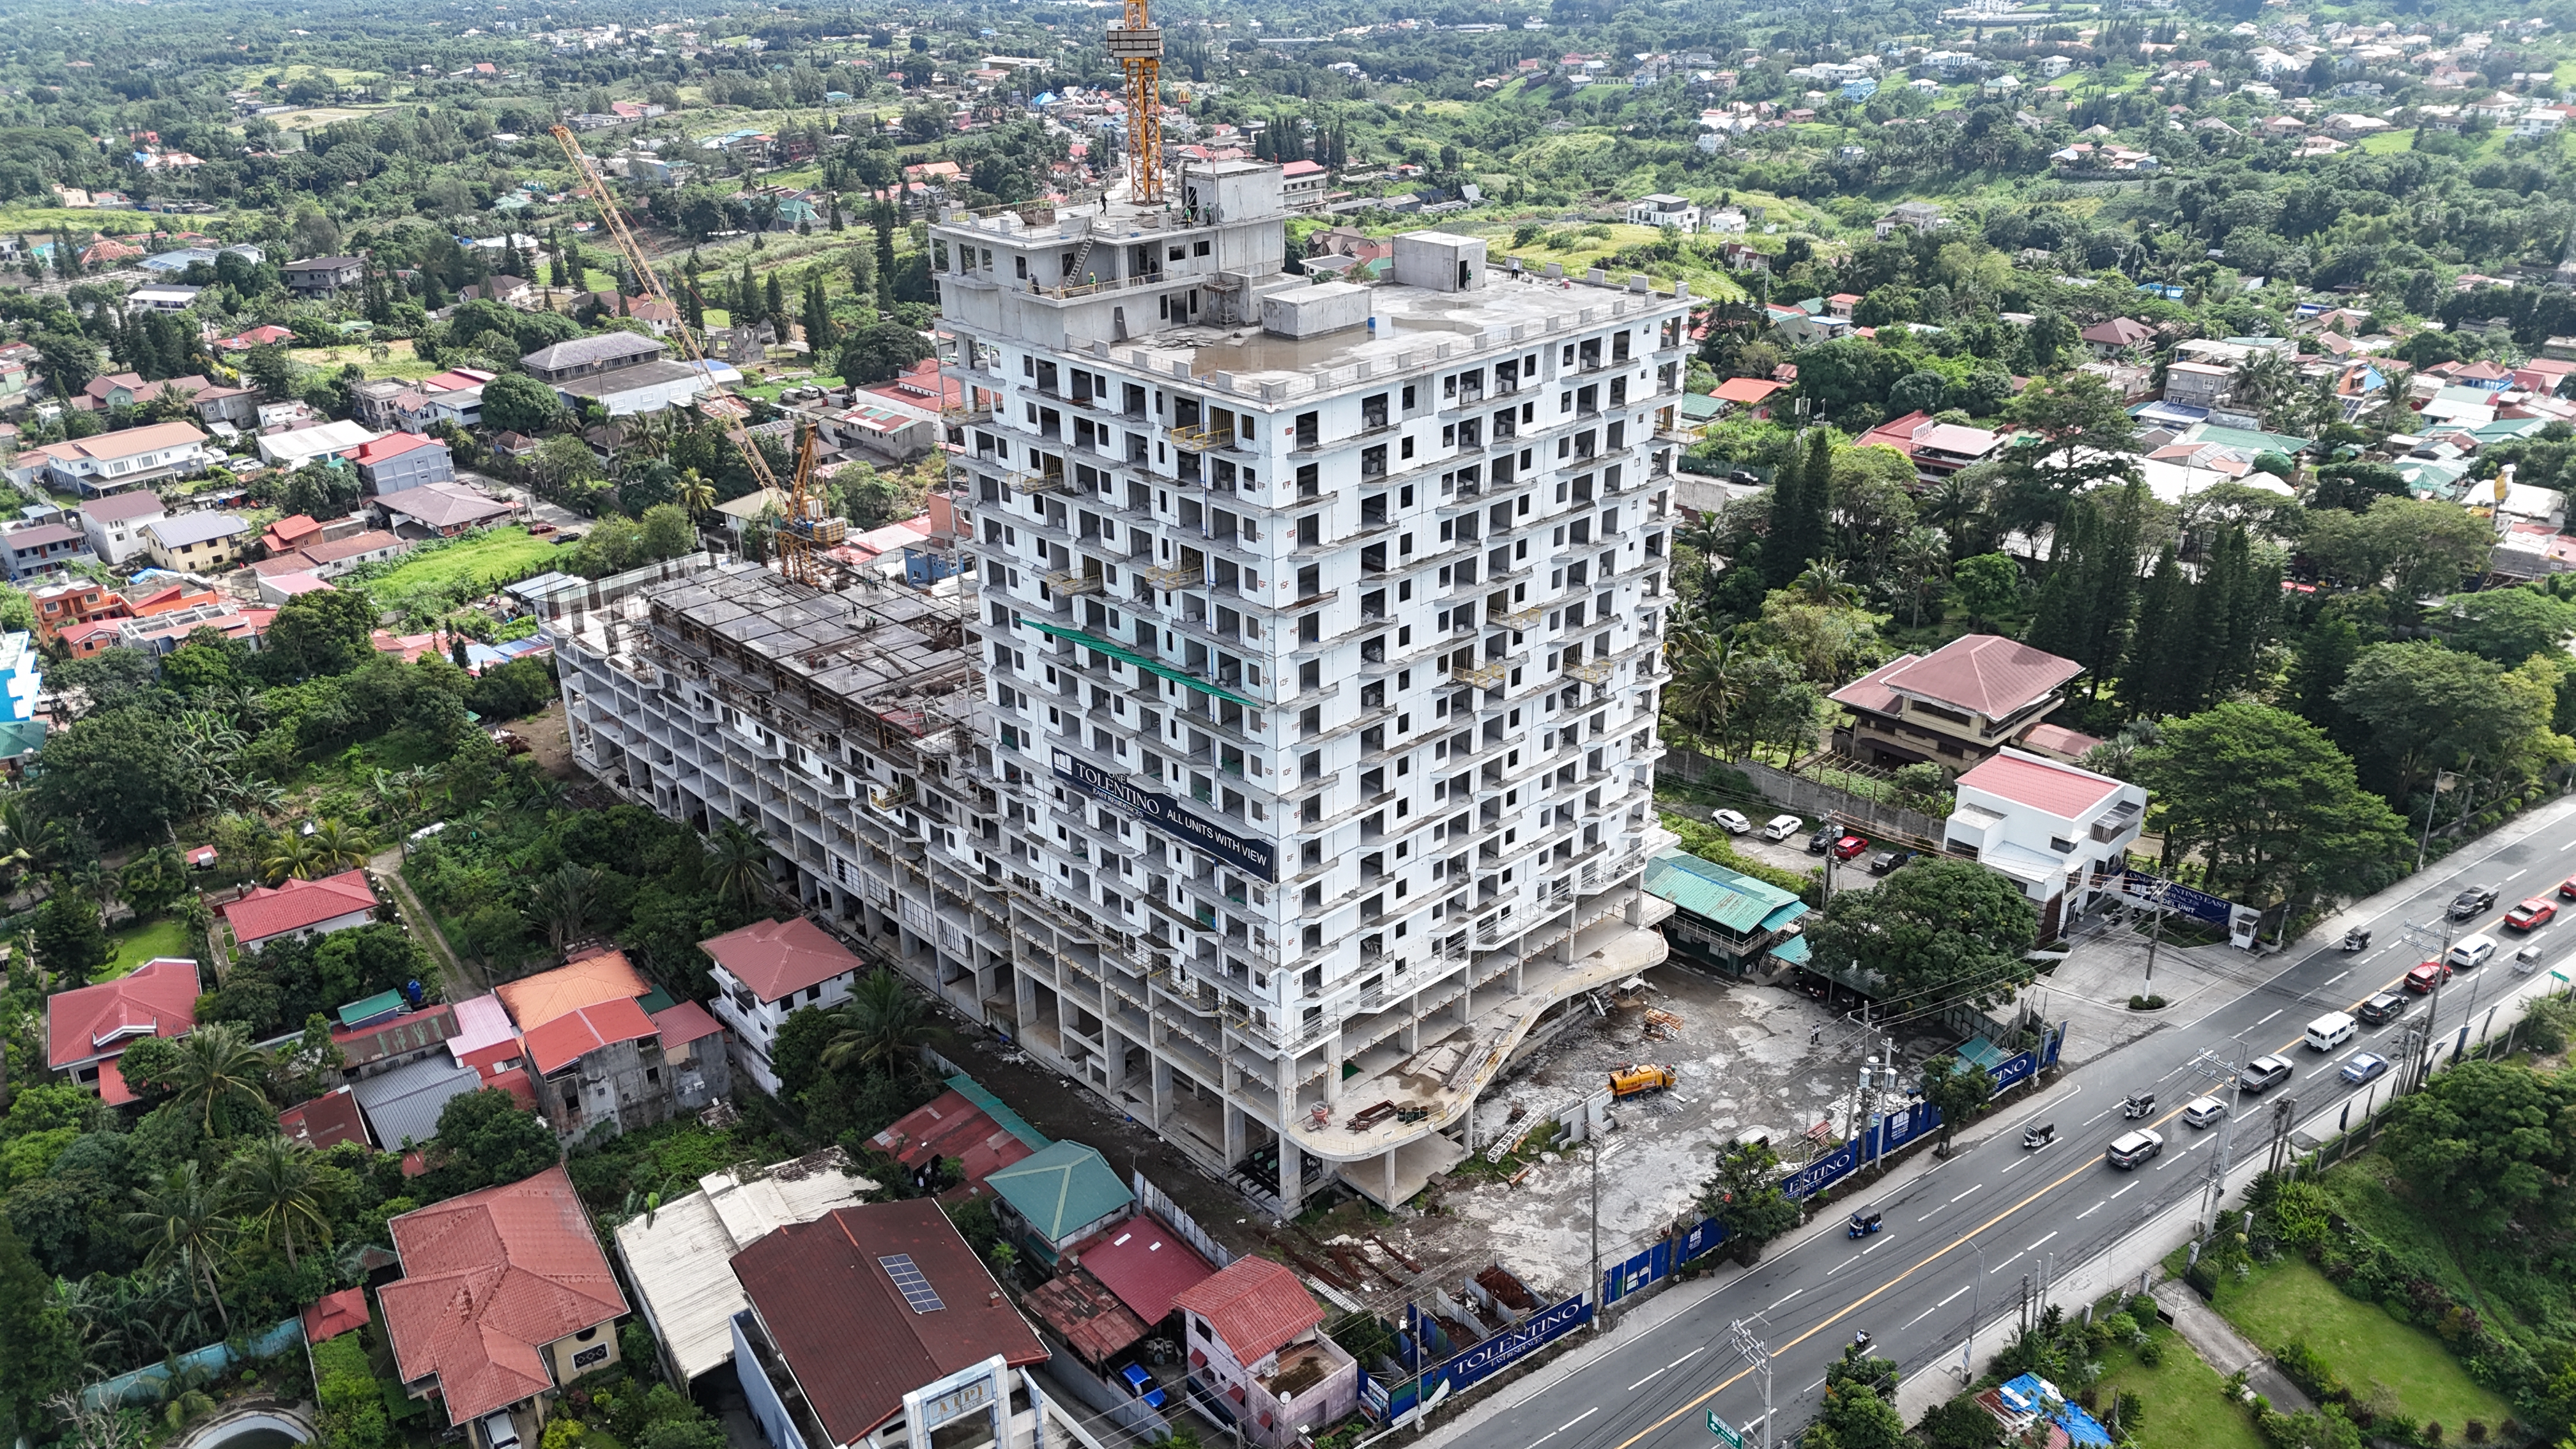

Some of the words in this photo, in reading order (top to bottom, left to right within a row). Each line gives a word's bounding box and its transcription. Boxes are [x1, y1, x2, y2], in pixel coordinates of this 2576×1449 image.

[1265, 767, 1273, 776] 10F
[1283, 767, 1292, 776] 10F
[1077, 763, 1160, 814] TOLENTINO
[1294, 809, 1301, 818] 9F
[1167, 809, 1183, 825] ALL
[1185, 816, 1213, 839] UNITS
[1215, 832, 1240, 853] WITH
[1241, 844, 1267, 866] VIEW
[1291, 894, 1299, 903] 7F
[2204, 897, 2228, 909] EAST
[2178, 903, 2196, 914] UNIT
[1288, 937, 1295, 946] 6F
[1454, 1304, 1579, 1374] TOLENTINO
